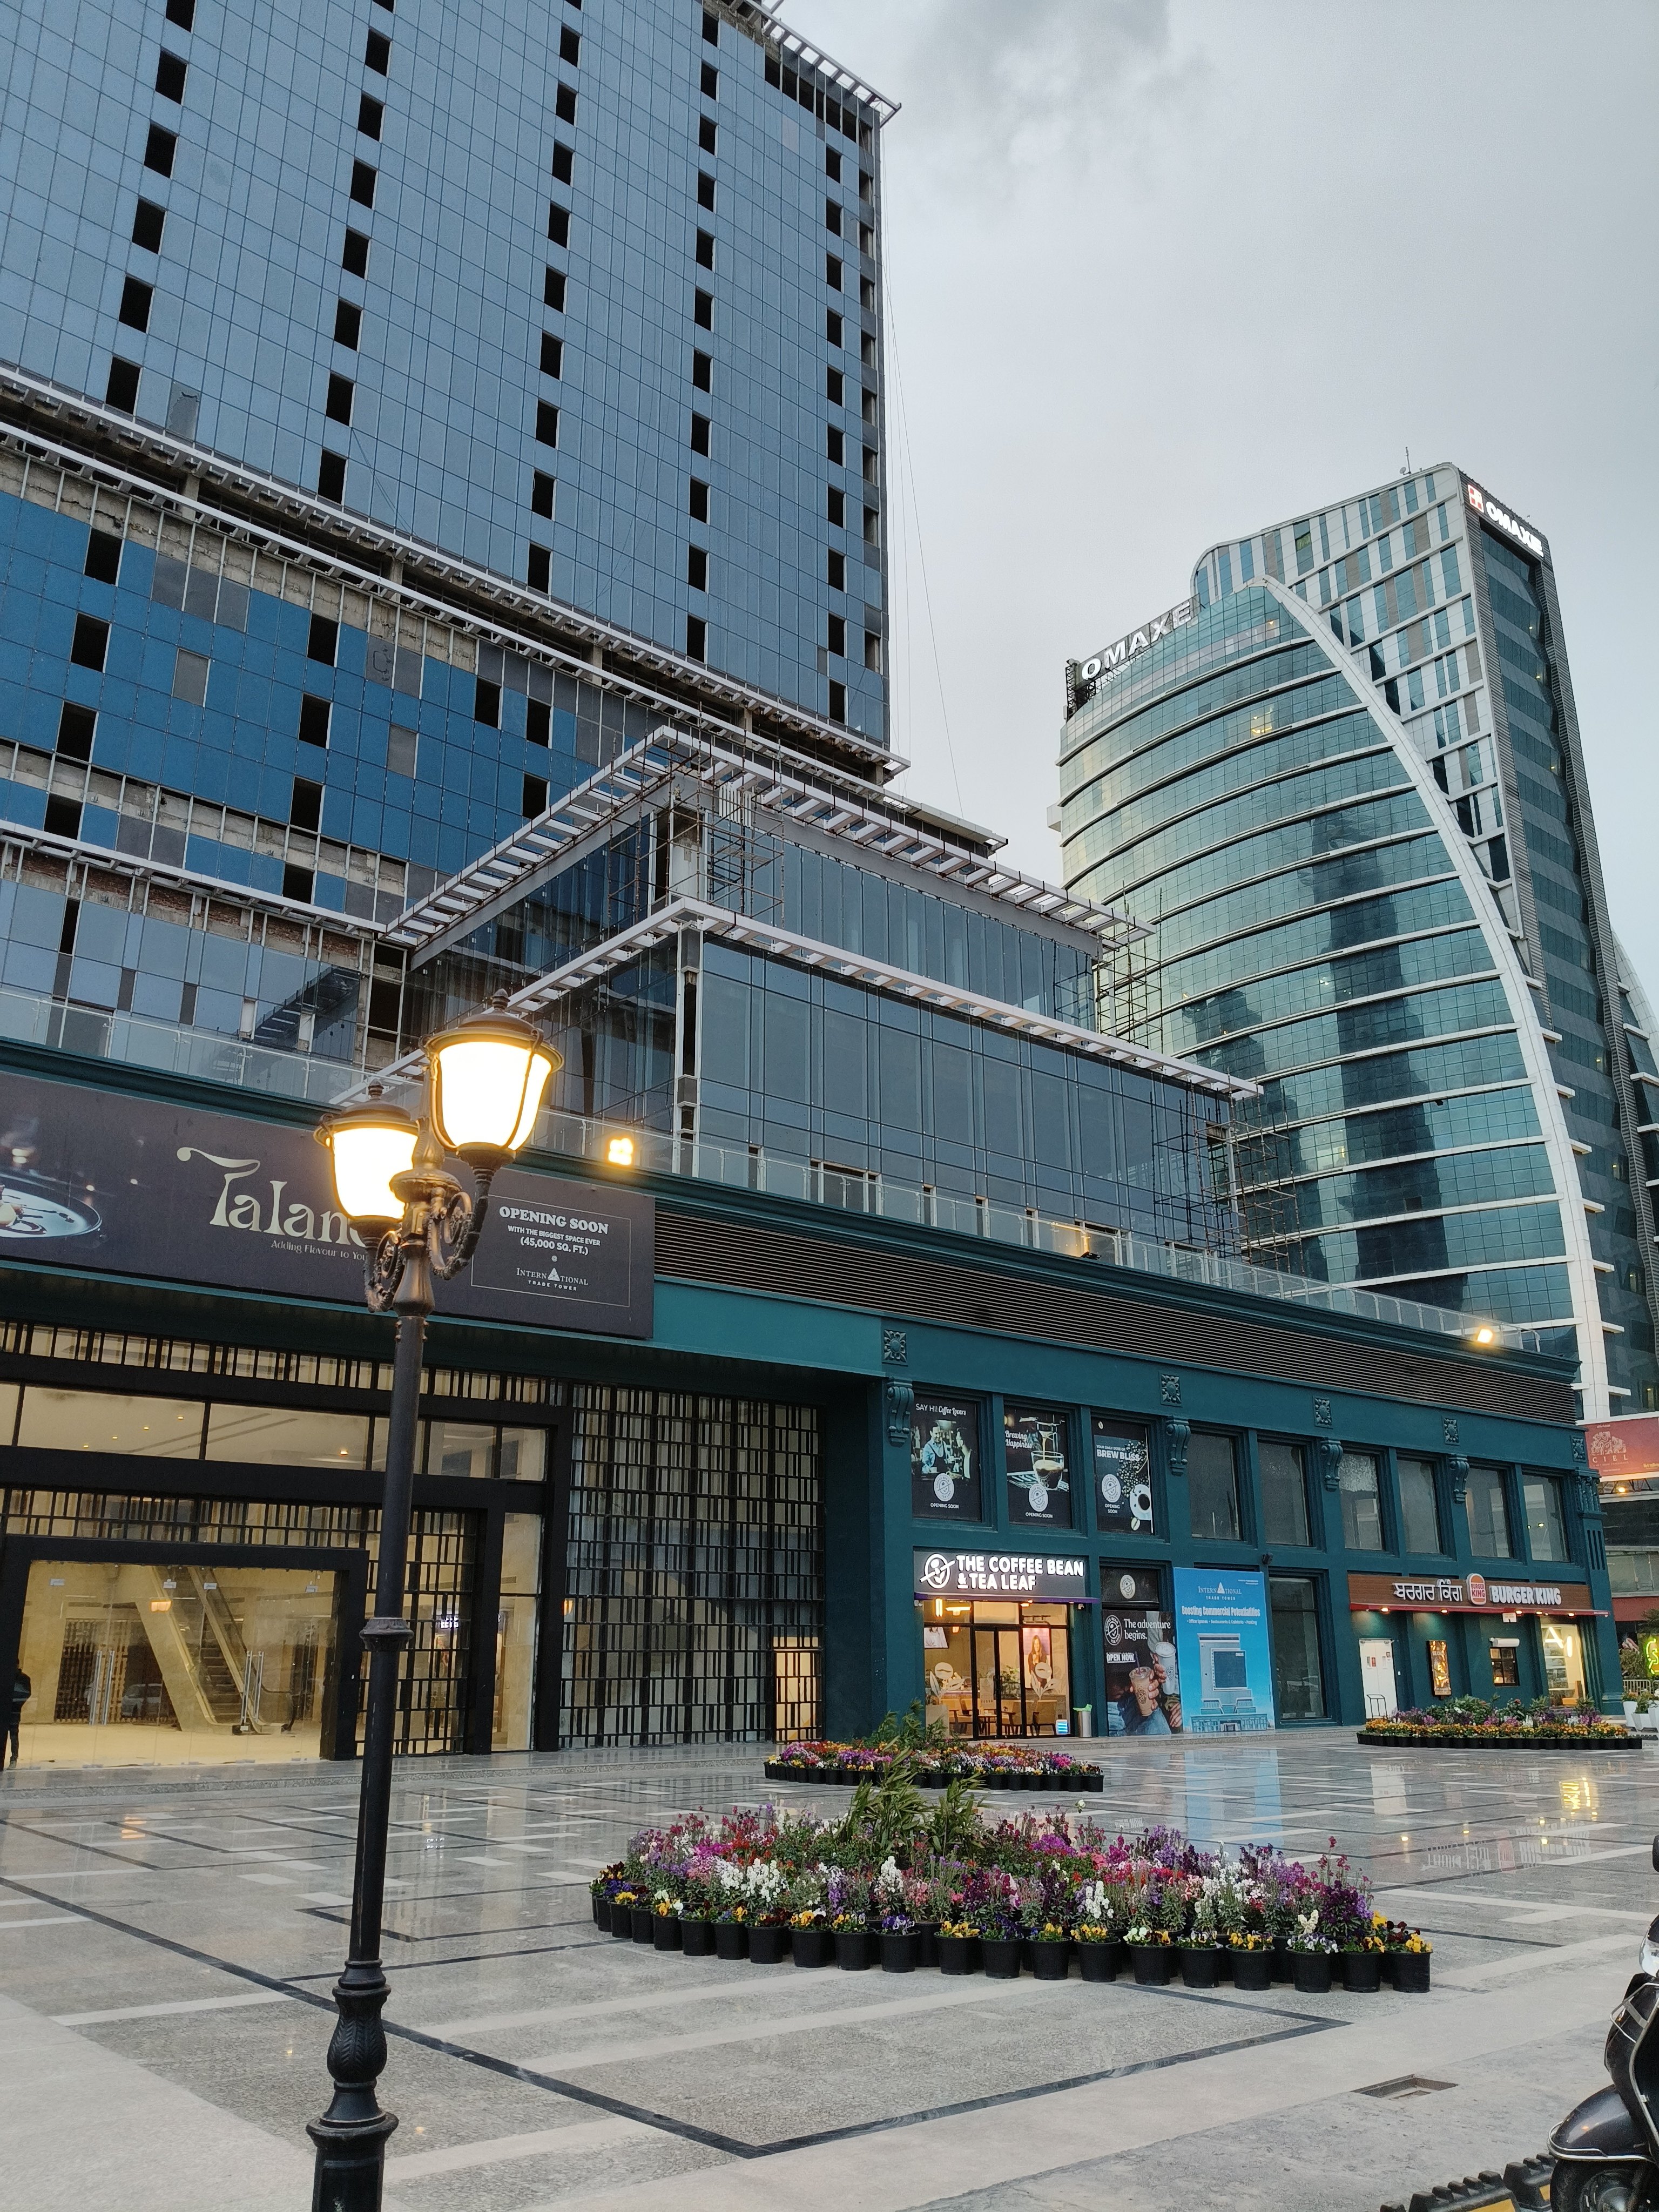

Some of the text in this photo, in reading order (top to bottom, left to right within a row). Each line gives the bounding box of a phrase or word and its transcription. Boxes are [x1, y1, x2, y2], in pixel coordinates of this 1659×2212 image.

[1486, 501, 1544, 557] OMAXE
[1082, 601, 1191, 680] OMAXE
[499, 1206, 609, 1235] OPENING SOON
[508, 1225, 601, 1246] WITH THE BIGGEST SPACE EVER
[271, 1240, 302, 1254] Adding
[305, 1244, 337, 1257] Flavour
[520, 1236, 589, 1256] (45,000 SQ. FT.)
[915, 1403, 928, 1411] SAY
[1004, 1430, 1027, 1442] Brewing
[1005, 1439, 1032, 1449] Happiness
[1096, 1449, 1140, 1462] BREW BLISS
[1592, 1454, 1628, 1463] CIEL
[956, 1555, 1084, 1576] THE COFFEE BEAN
[957, 1572, 1036, 1590] & TEA LEAF
[1392, 1579, 1462, 1601] ਬਰਗਰ ਕਿੰਗ
[1471, 1589, 1486, 1598] KING
[1489, 1585, 1562, 1605] BURGER KING
[1182, 1606, 1260, 1617] Boosting Commercial Potentialities
[1123, 1618, 1171, 1629] The adventure
[1124, 1630, 1148, 1641] begins.
[1107, 1653, 1135, 1661] OPEN NOW
